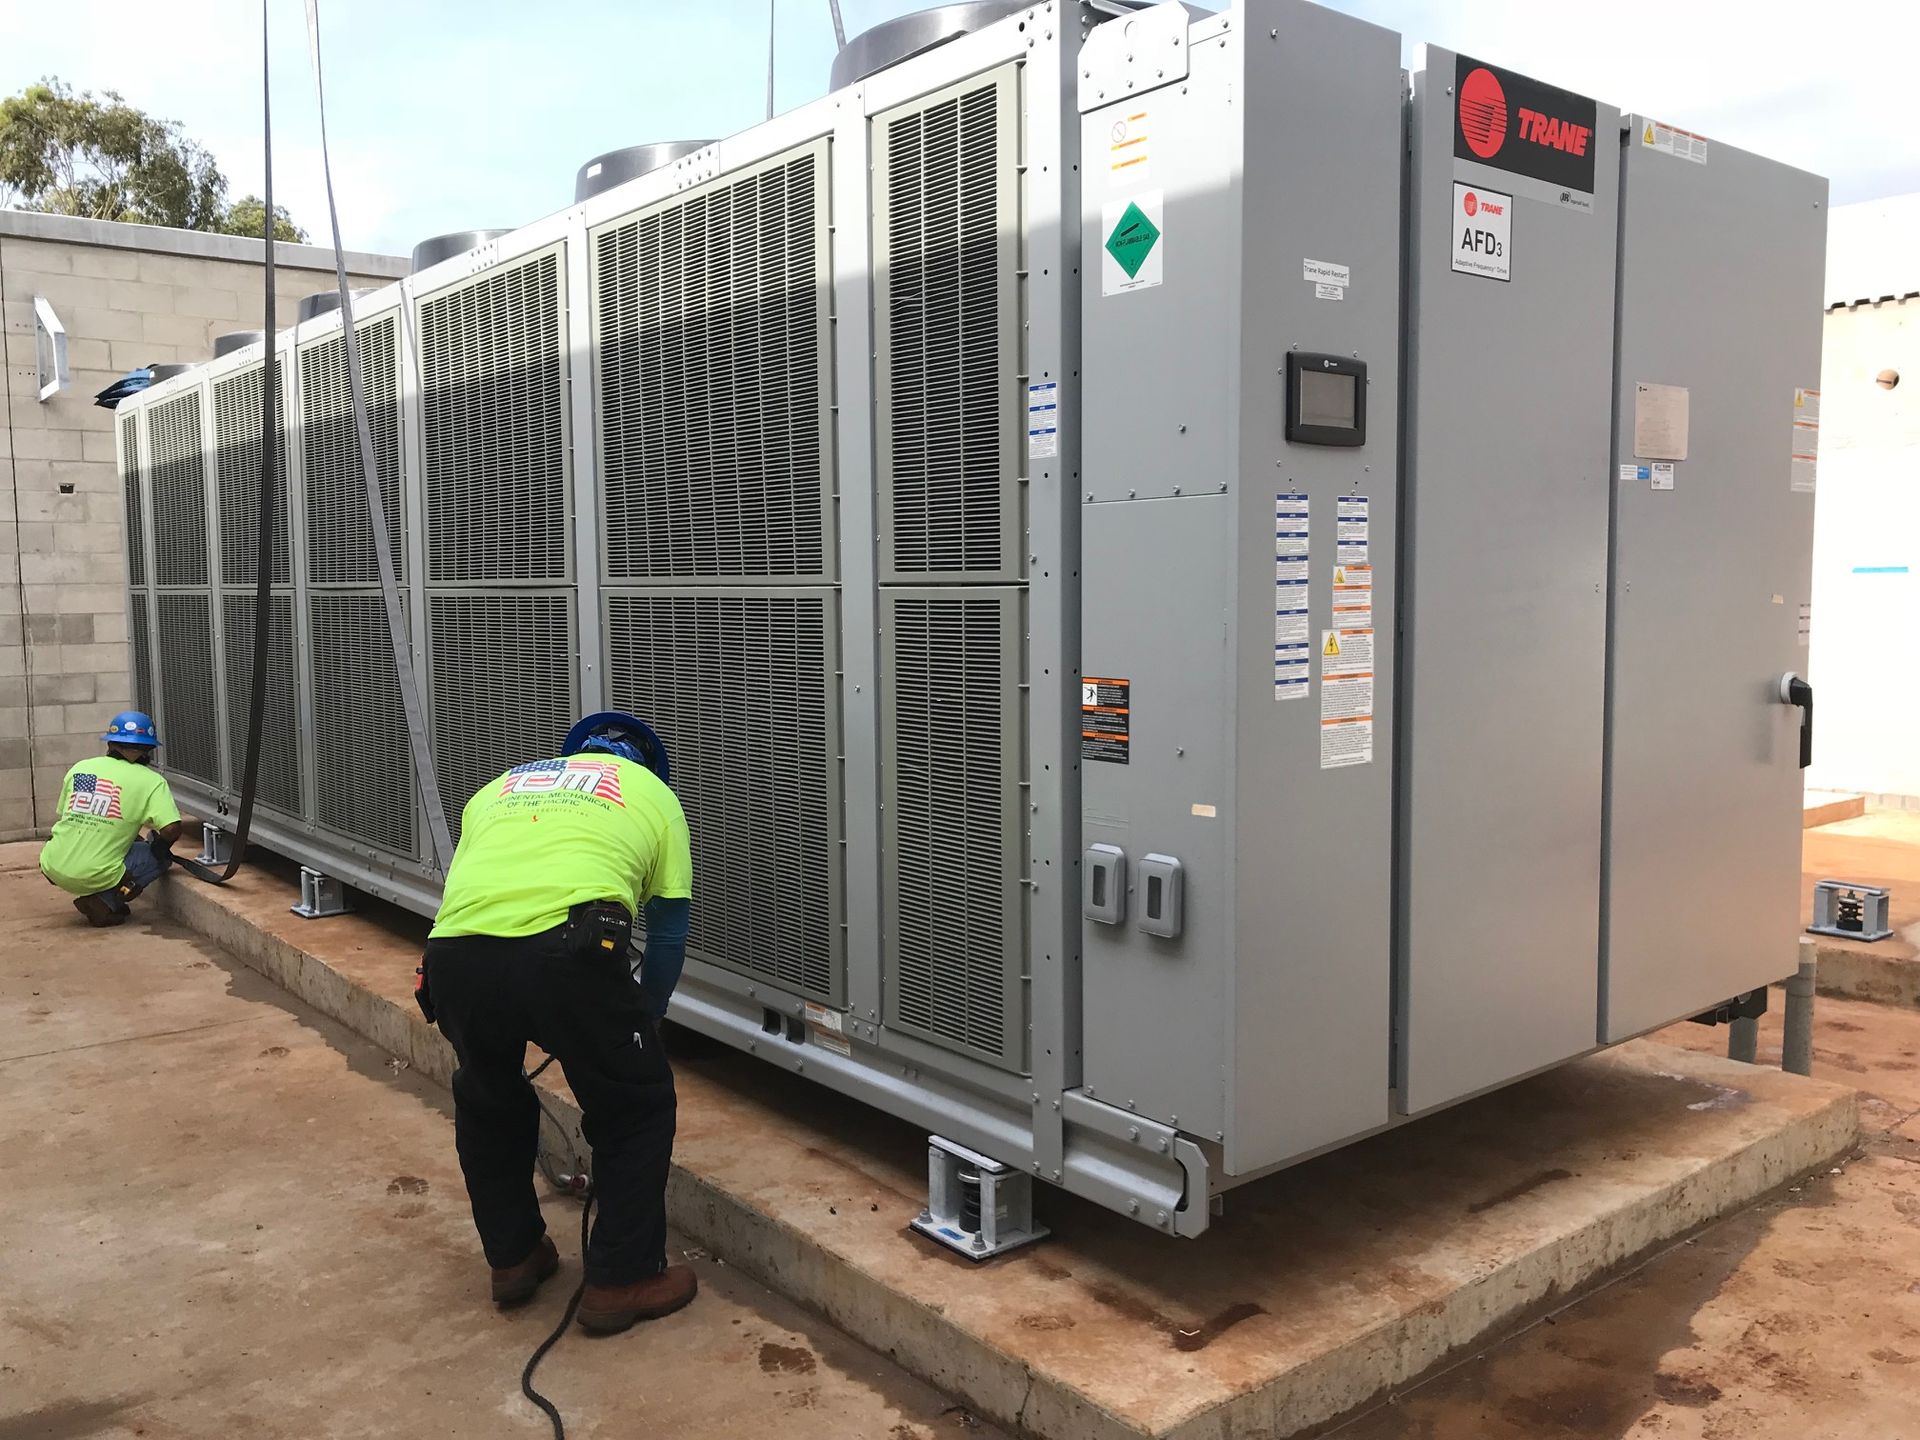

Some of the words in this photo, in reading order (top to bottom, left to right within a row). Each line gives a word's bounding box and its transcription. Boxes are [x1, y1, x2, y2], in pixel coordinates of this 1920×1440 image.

[1518, 107, 1588, 157] TRANE
[1480, 202, 1503, 215] TRANE
[507, 801, 520, 809] OF
[523, 799, 543, 808] THE
[548, 791, 612, 812] MECHANICAL
